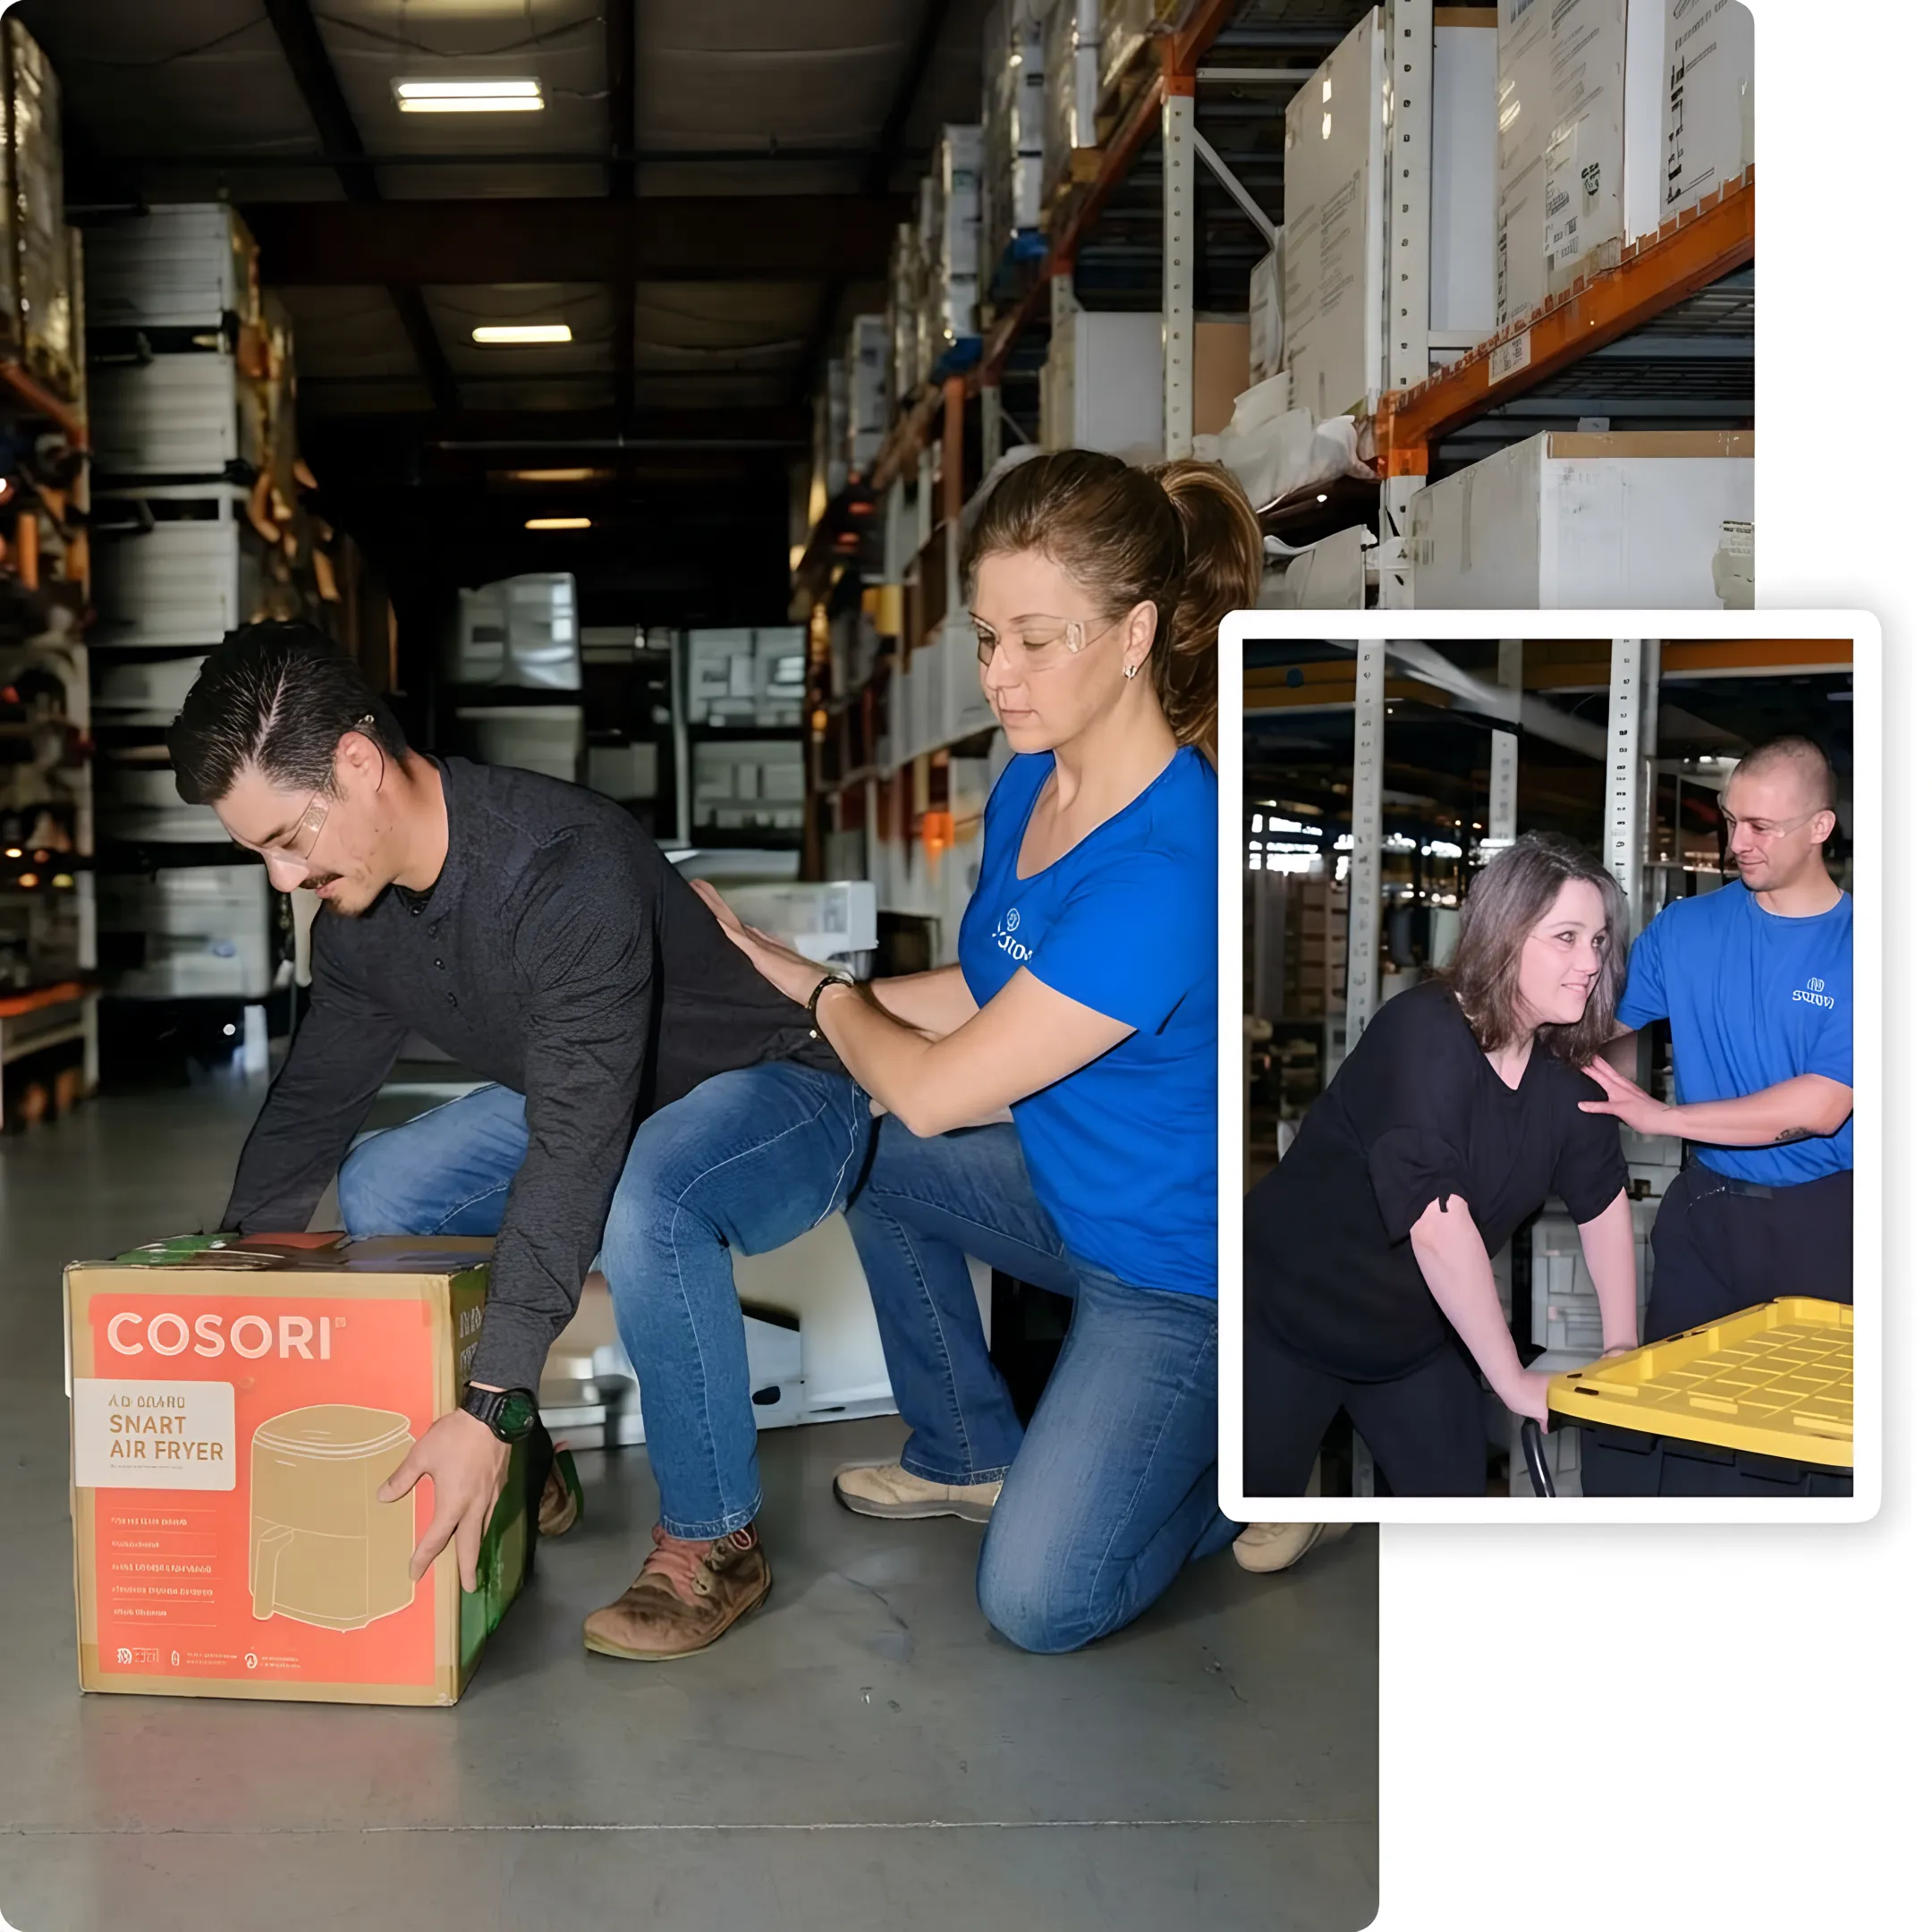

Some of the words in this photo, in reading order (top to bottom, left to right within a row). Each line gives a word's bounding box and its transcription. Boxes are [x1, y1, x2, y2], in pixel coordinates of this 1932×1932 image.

[106, 1311, 331, 1360] COSORI
[110, 1439, 146, 1459] AIR
[154, 1440, 224, 1461] FRYER
